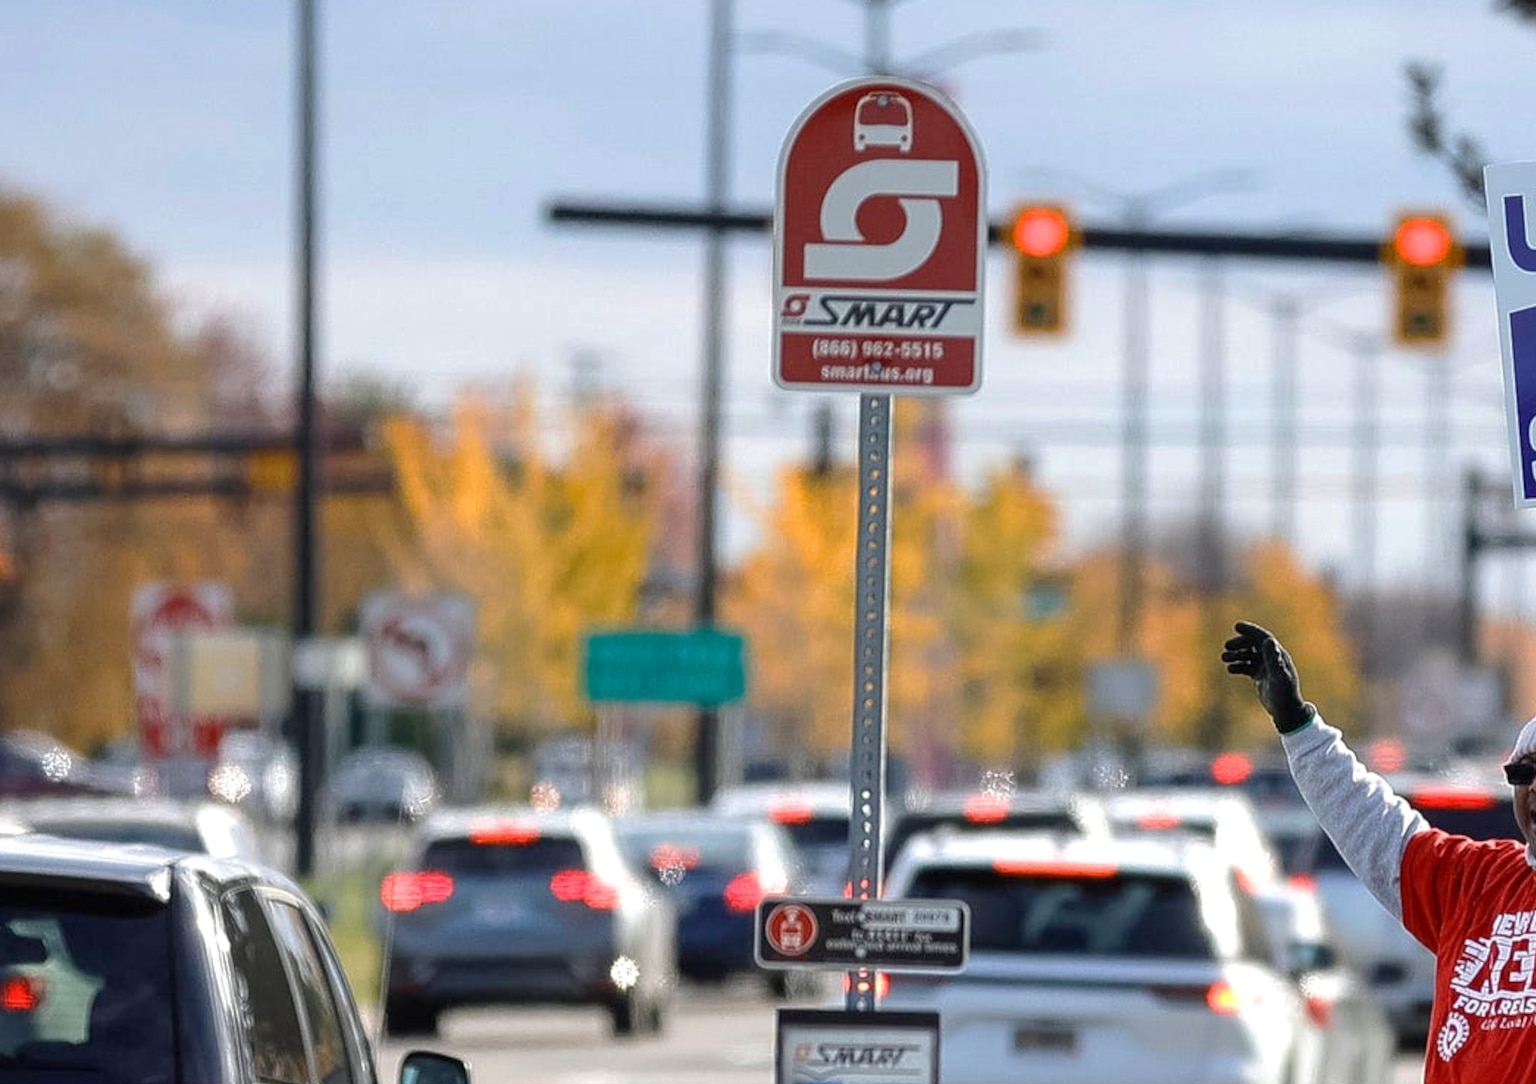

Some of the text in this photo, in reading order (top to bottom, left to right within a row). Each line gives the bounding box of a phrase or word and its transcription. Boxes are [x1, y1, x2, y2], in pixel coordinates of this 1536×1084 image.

[804, 295, 976, 329] SMART
[821, 363, 933, 384] smartus.org
[803, 1043, 920, 1066] SMART
